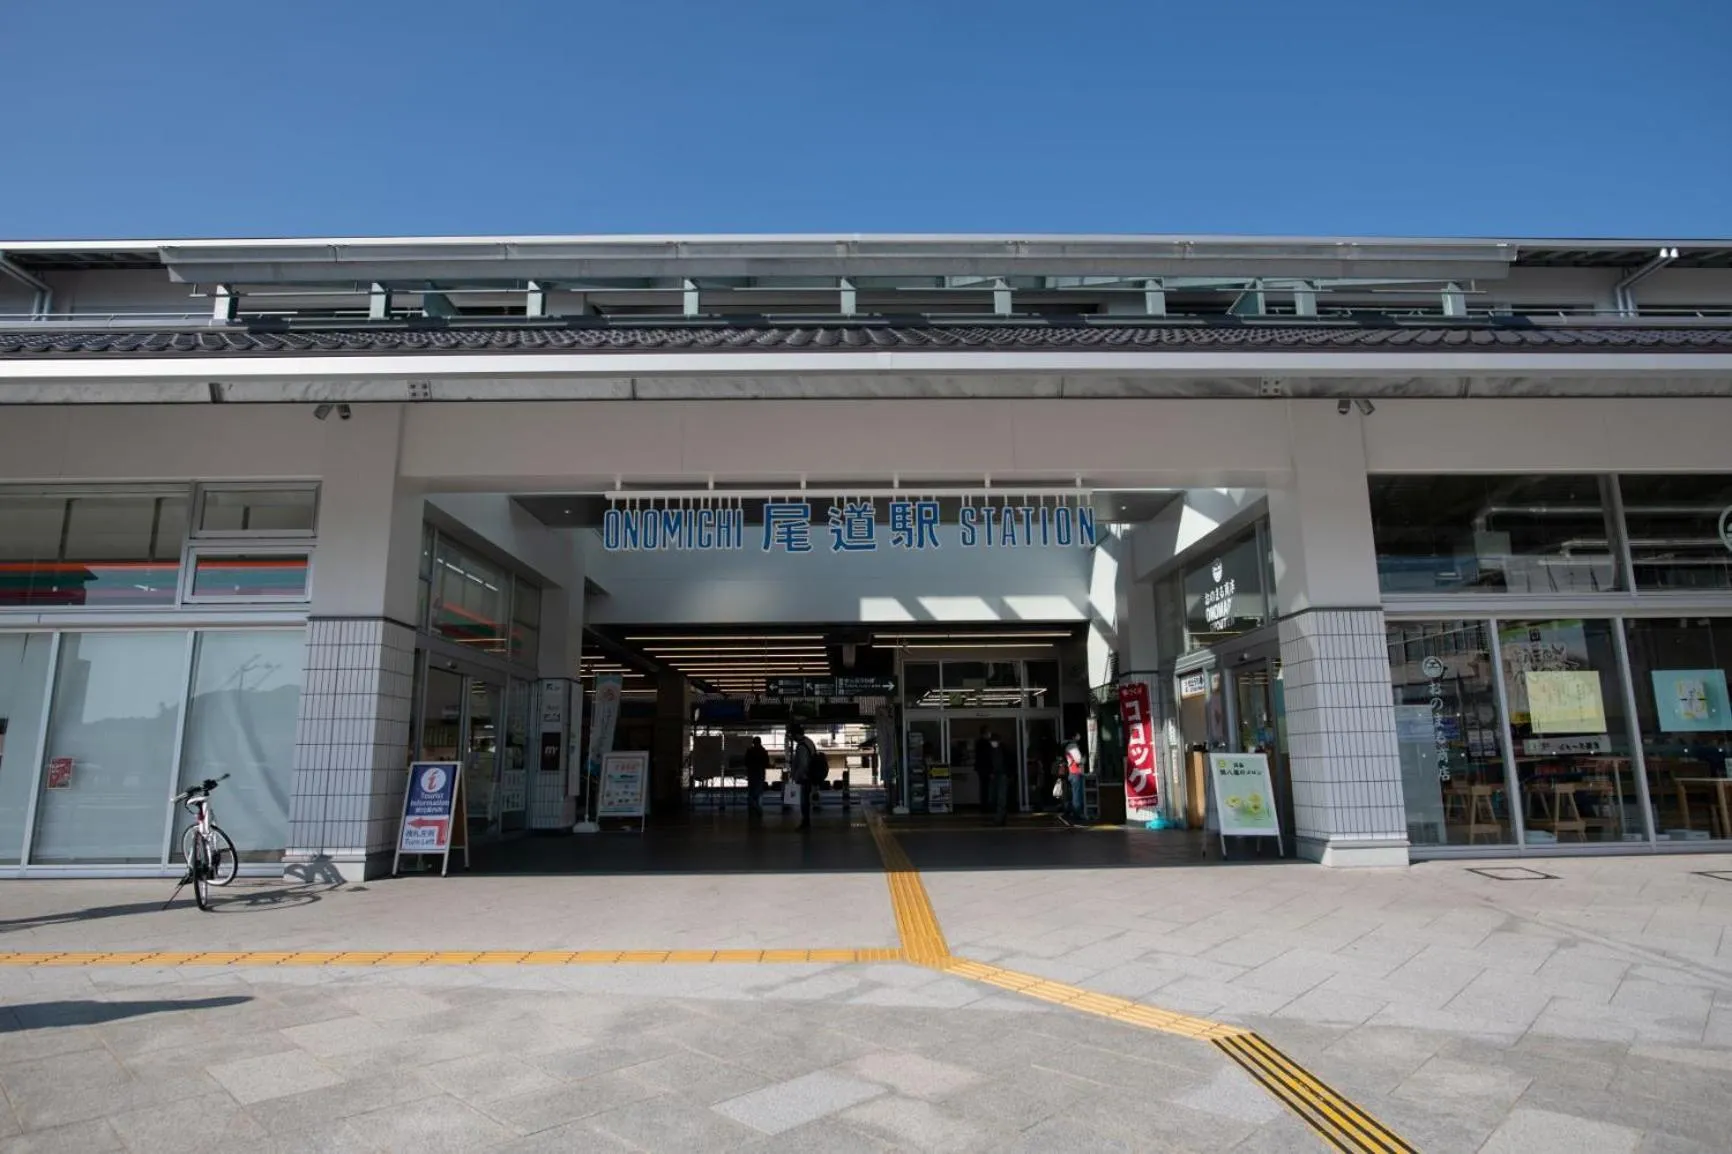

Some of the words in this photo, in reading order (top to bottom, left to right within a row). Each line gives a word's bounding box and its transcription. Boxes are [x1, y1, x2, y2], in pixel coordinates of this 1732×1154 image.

[603, 508, 744, 551] ONOMICHI
[761, 501, 940, 552] 尾道駅
[961, 507, 1096, 548] STATION
[1125, 700, 1152, 793] コロッケ
